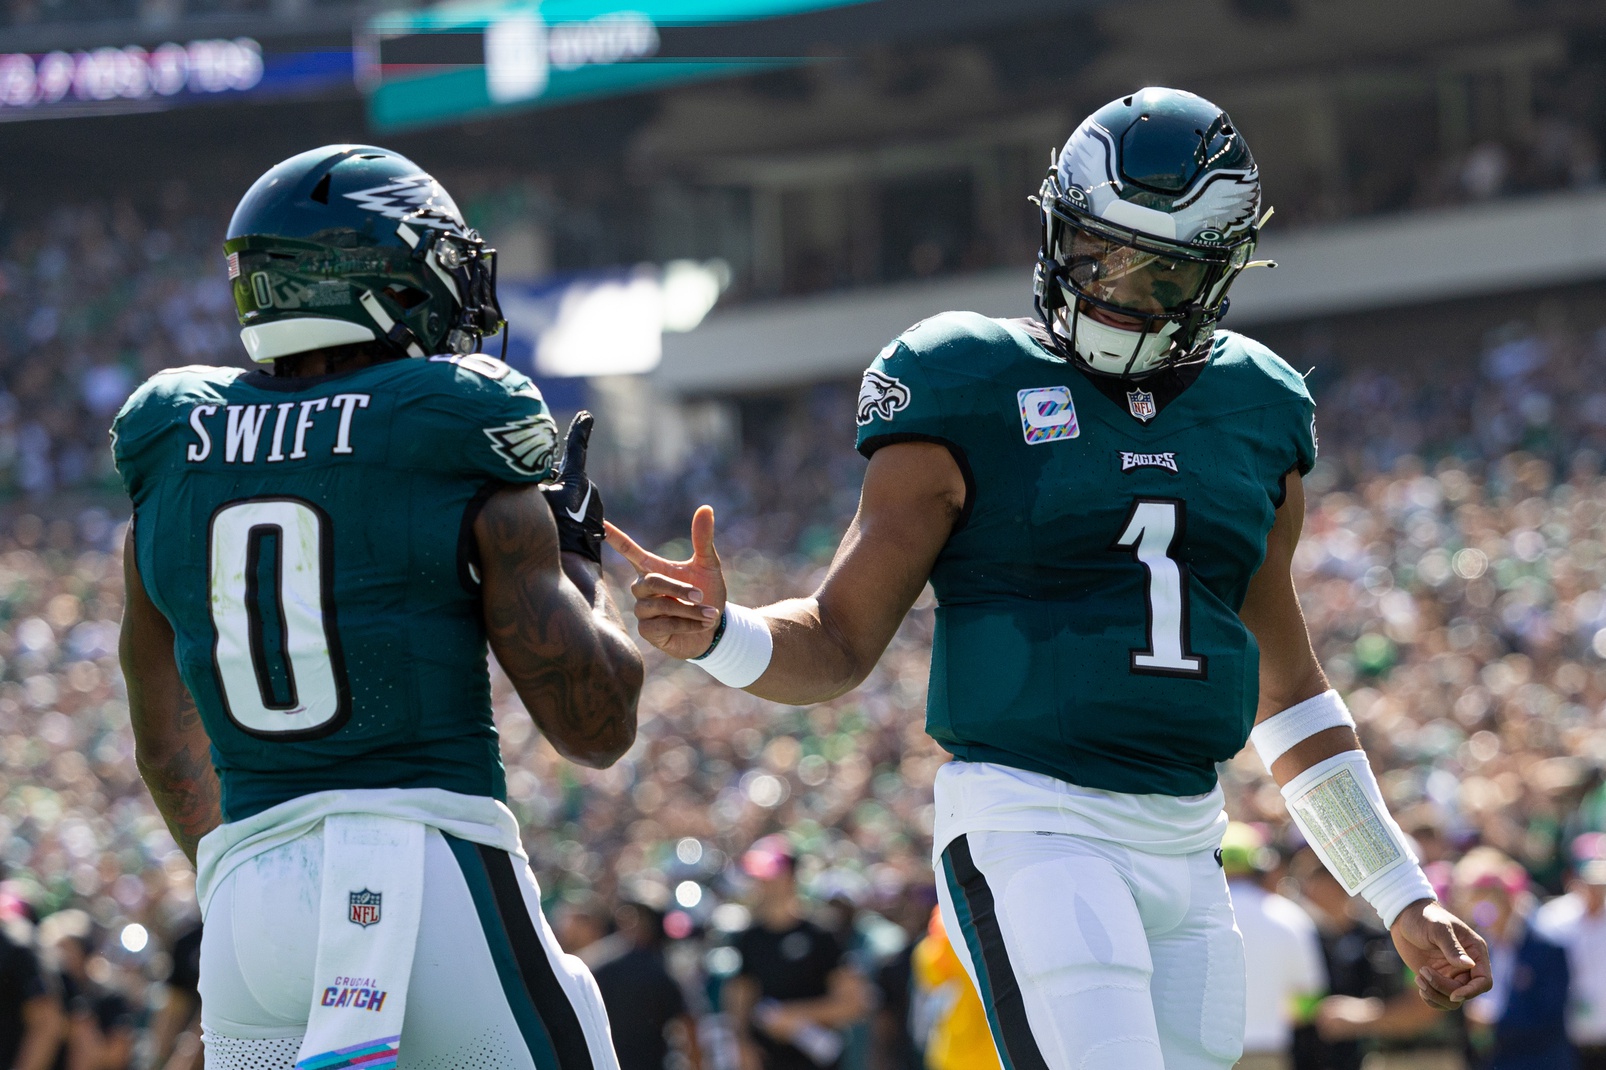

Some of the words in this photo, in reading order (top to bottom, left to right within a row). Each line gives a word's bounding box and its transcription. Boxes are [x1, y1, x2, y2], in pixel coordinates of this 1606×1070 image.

[1065, 195, 1088, 209] OAKLEY
[1192, 238, 1221, 246] OAKLEY
[1024, 390, 1073, 428] C
[1134, 402, 1152, 416] NFL
[187, 393, 371, 463] SWIFT
[1119, 451, 1179, 473] EAGLES
[1112, 497, 1205, 678] 1
[208, 496, 346, 739] 0
[352, 905, 378, 923] NFL
[334, 976, 377, 988] CRUCIAL
[321, 987, 387, 1012] CATCH
